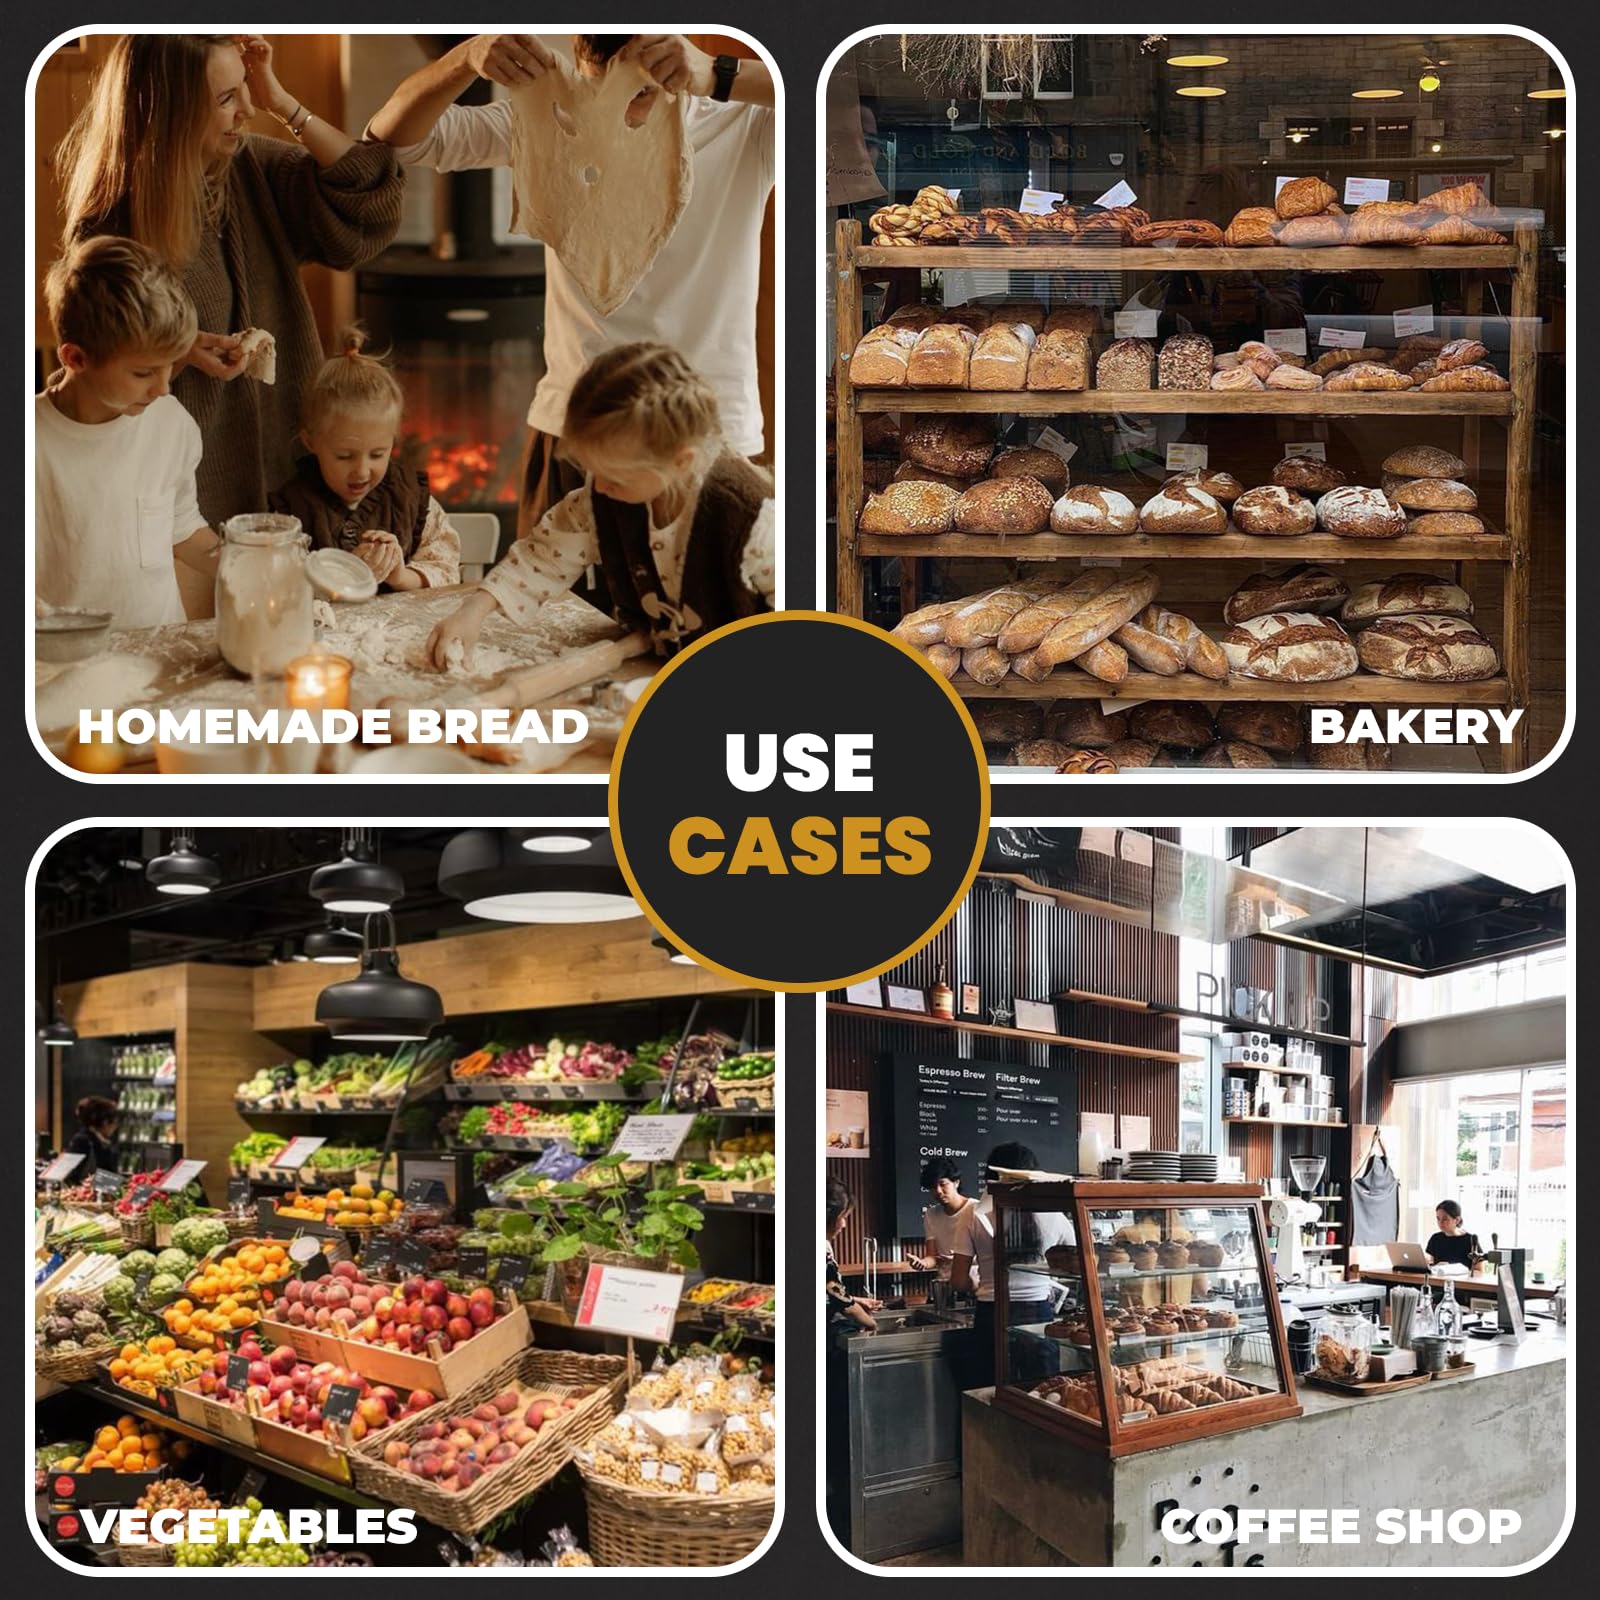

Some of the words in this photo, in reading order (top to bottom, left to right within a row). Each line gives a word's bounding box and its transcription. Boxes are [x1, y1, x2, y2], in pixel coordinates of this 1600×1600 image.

[918, 1065, 961, 1077] Espresso
[963, 1069, 986, 1079] Brew
[995, 1073, 1018, 1084] Filter
[1019, 1075, 1041, 1085] Brew
[920, 1146, 943, 1156] Cold
[944, 1148, 968, 1157] Brew
